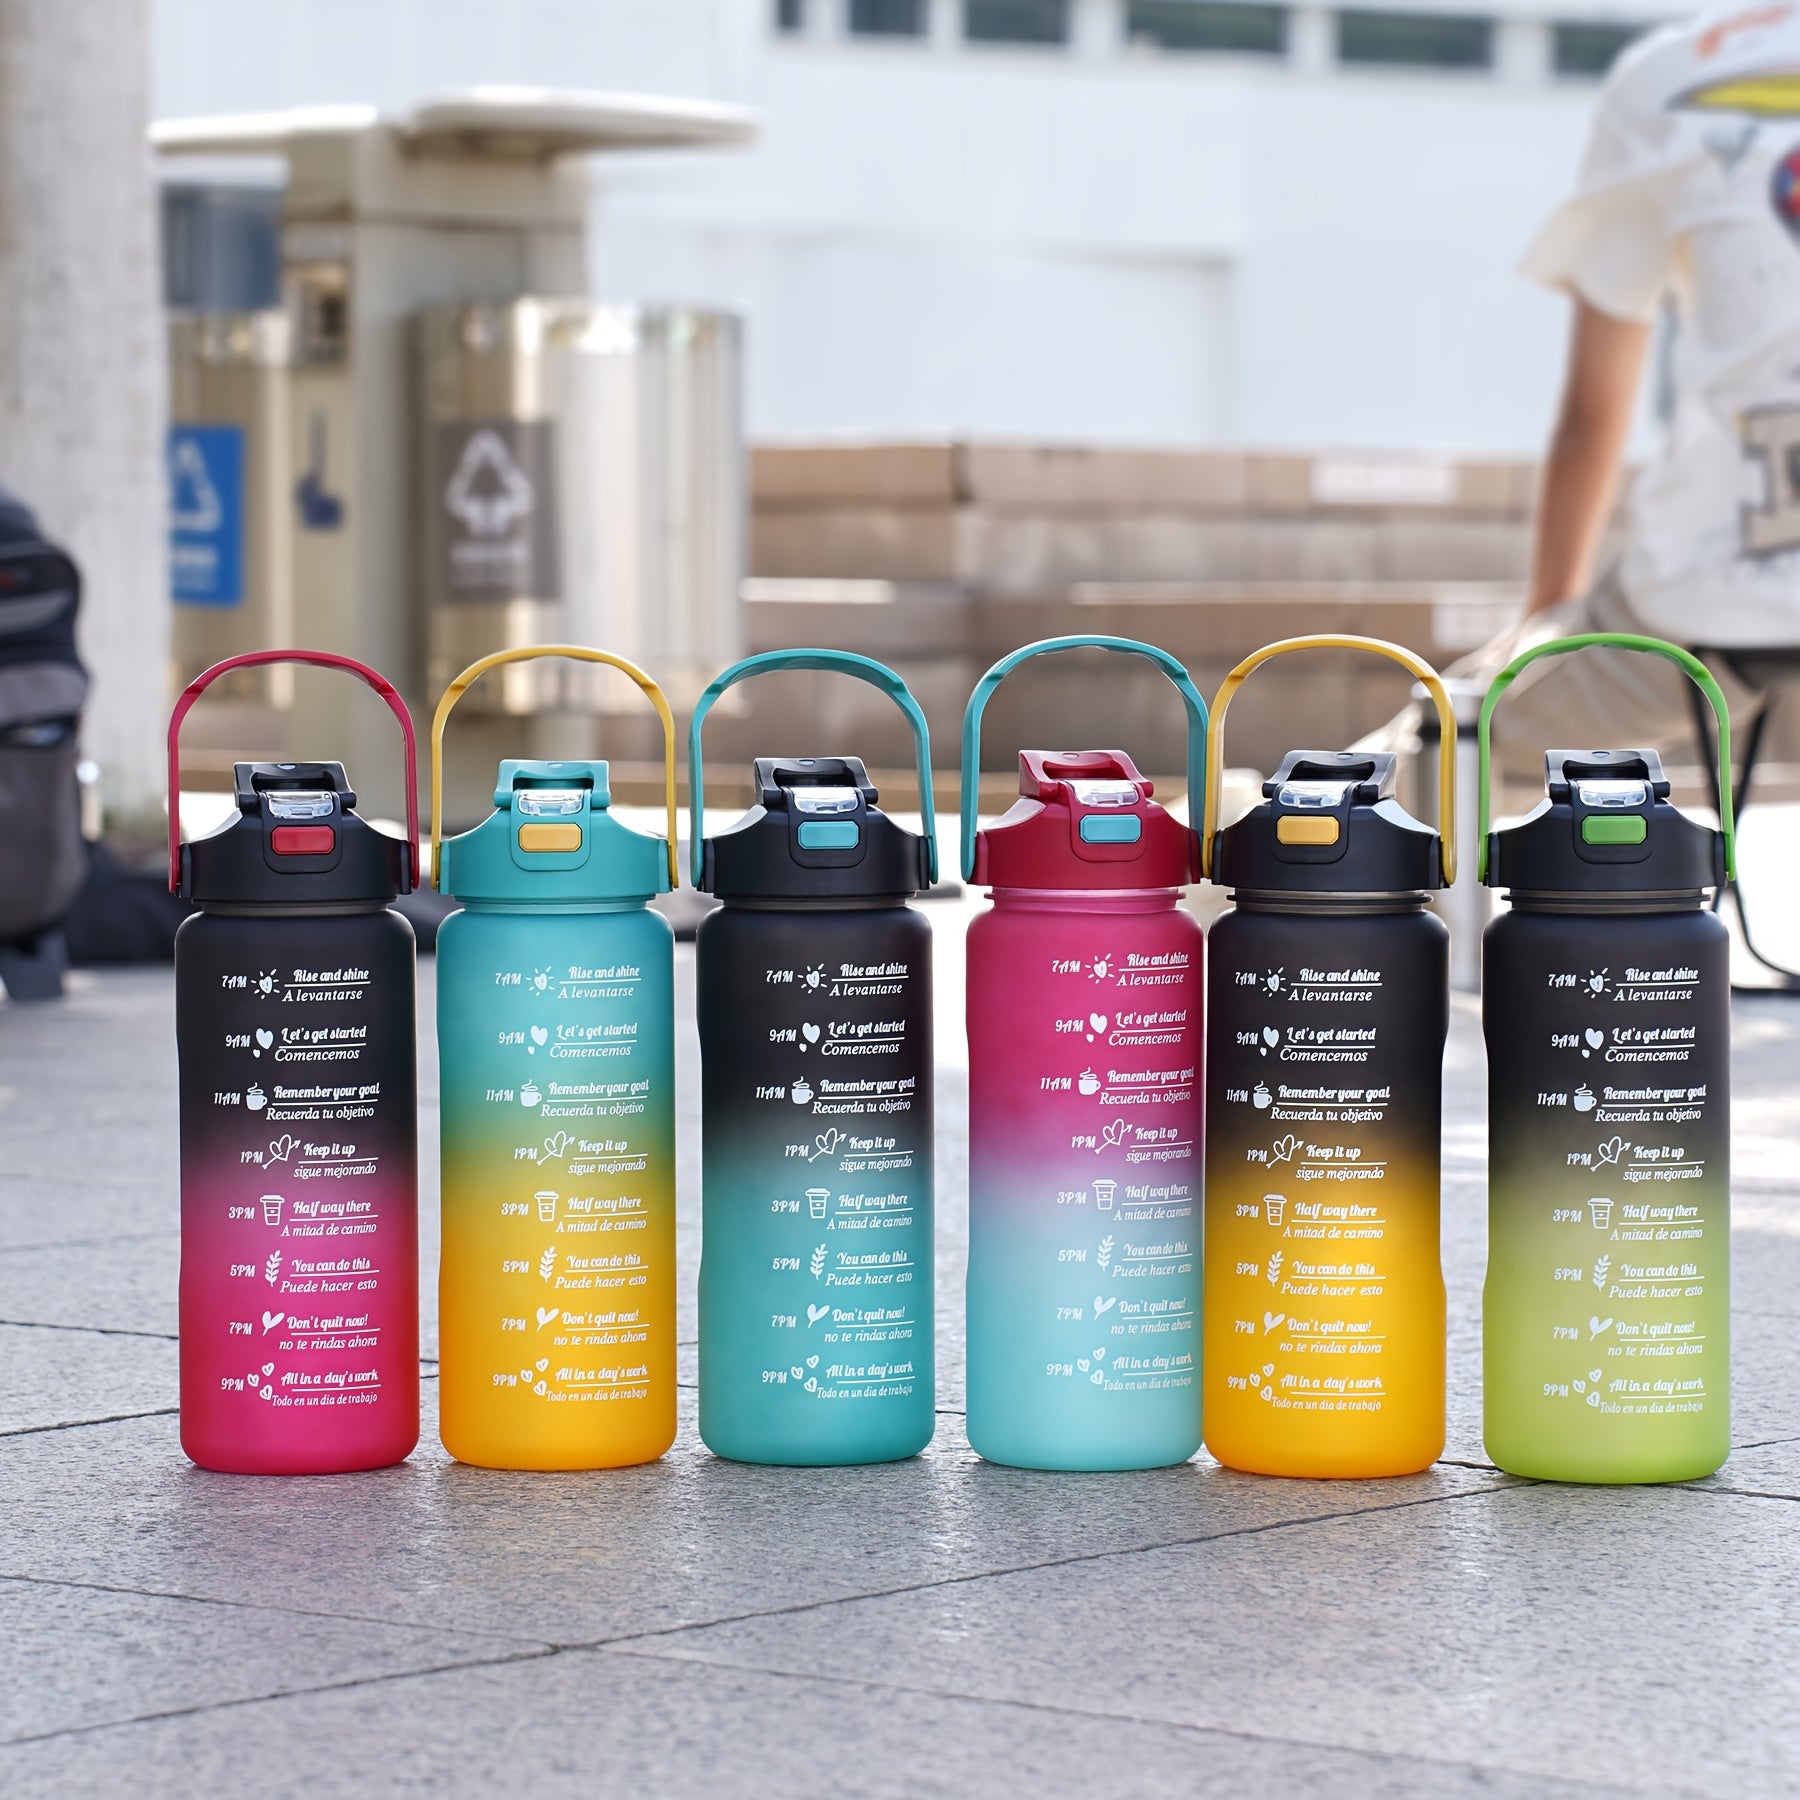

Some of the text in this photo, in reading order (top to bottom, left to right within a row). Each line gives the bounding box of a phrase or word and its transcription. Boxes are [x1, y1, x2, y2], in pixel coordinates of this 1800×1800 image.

[1052, 960, 1081, 973] 7AM
[1127, 952, 1189, 967] Rise and shine
[568, 964, 640, 979] Rise and shine
[766, 970, 793, 983] 7AM
[840, 962, 908, 977] Rise and shine
[1625, 967, 1699, 982] Rise and shine
[221, 976, 247, 989] 7AM
[495, 973, 521, 986] 7AM
[1116, 973, 1184, 986] A levantarse
[1235, 972, 1256, 986] 7AM
[1548, 974, 1577, 988] 7AM
[281, 989, 363, 1002] A levantarse
[557, 986, 634, 999] A levantarse
[829, 983, 903, 996] A levantarse
[1288, 988, 1372, 1001] A levantarse
[1613, 988, 1693, 1001] A levantarse
[828, 1020, 905, 1038] Let's get started
[1055, 1019, 1084, 1033] 9AM
[281, 1025, 367, 1044] Let's get started
[498, 1031, 525, 1045] 9AM
[769, 1029, 797, 1043] 9AM
[1108, 1032, 1181, 1046] Comencemos
[1236, 1031, 1258, 1045] 9AM
[1551, 1034, 1579, 1048] 9AM
[225, 1035, 250, 1049] 9AM
[821, 1042, 900, 1055] Comencemos
[274, 1049, 360, 1062] Comencemos
[550, 1045, 632, 1058] Comencemos
[1279, 1048, 1368, 1062] Comencemos
[1604, 1049, 1690, 1062] Comencemos
[1040, 1077, 1072, 1091] 11AM
[214, 1092, 241, 1105] 11AM
[486, 1089, 514, 1102] 11AM
[755, 1086, 785, 1099] 11AM
[1099, 1089, 1191, 1105] Recuerda tu objetivo
[1226, 1089, 1249, 1103] 11AM
[1537, 1093, 1567, 1106] 11AM
[265, 1105, 375, 1120] Recuerda tu objetivo
[540, 1102, 644, 1117] Recuerda tu objetivo
[812, 1099, 911, 1114] Recuerda tu objetivo
[1270, 1107, 1383, 1123] Recuerda tu objetivo
[1595, 1108, 1702, 1123] Recuerda tu objetivo
[1071, 1135, 1096, 1148] 1PM
[1135, 1127, 1178, 1142] Keep it up
[241, 1151, 263, 1164] 1PM
[514, 1148, 538, 1160] 1PM
[785, 1145, 809, 1157] 1PM
[1125, 1146, 1192, 1163] sigue mejorando
[1247, 1149, 1267, 1162] 1PM
[1634, 1146, 1685, 1161] Keep it up
[839, 1155, 913, 1173] sigue mejorando
[1567, 1153, 1592, 1165] 1PM
[293, 1162, 376, 1180] sigue mejorando
[568, 1158, 646, 1175] sigue mejorando
[1623, 1165, 1703, 1182] sigue mejorando
[1295, 1167, 1385, 1182] sigue mejorando
[1057, 1191, 1087, 1204] 3PM
[501, 1203, 529, 1216] 3PM
[567, 1197, 641, 1213] Half way there
[771, 1200, 800, 1213] 3PM
[1235, 1204, 1259, 1218] 3PM
[1294, 1203, 1377, 1220] Half way there
[228, 1206, 255, 1220] 3PM
[1553, 1209, 1582, 1223] 3PM
[1058, 1250, 1087, 1262] 5PM
[230, 1264, 256, 1277] 5PM
[502, 1261, 530, 1274] 5PM
[772, 1258, 800, 1270] 5PM
[1112, 1262, 1192, 1278] Puede hacer esto
[1236, 1262, 1258, 1276] 5PM
[825, 1271, 913, 1286] Puede hacer esto
[1553, 1268, 1582, 1281] 5PM
[280, 1279, 378, 1293] Puede hacer esto
[554, 1275, 647, 1289] Puede hacer esto
[1280, 1282, 1383, 1296] Puede hacer esto
[1608, 1284, 1703, 1298] Puede hacer esto
[1056, 1307, 1083, 1320] 7PM
[229, 1322, 252, 1335] 7PM
[286, 1314, 369, 1331] Don't quit now!
[501, 1318, 526, 1331] 7PM
[771, 1315, 797, 1328] 7PM
[1234, 1320, 1255, 1334] 7PM
[1287, 1318, 1372, 1335] Don't quit now!
[1552, 1327, 1579, 1340] 7PM
[1046, 1364, 1073, 1376] 9PM
[221, 1378, 244, 1391] 9PM
[492, 1374, 517, 1386] 9PM
[762, 1371, 787, 1384] 9PM
[1227, 1376, 1247, 1389] 9PM
[1543, 1383, 1569, 1397] 9PM
